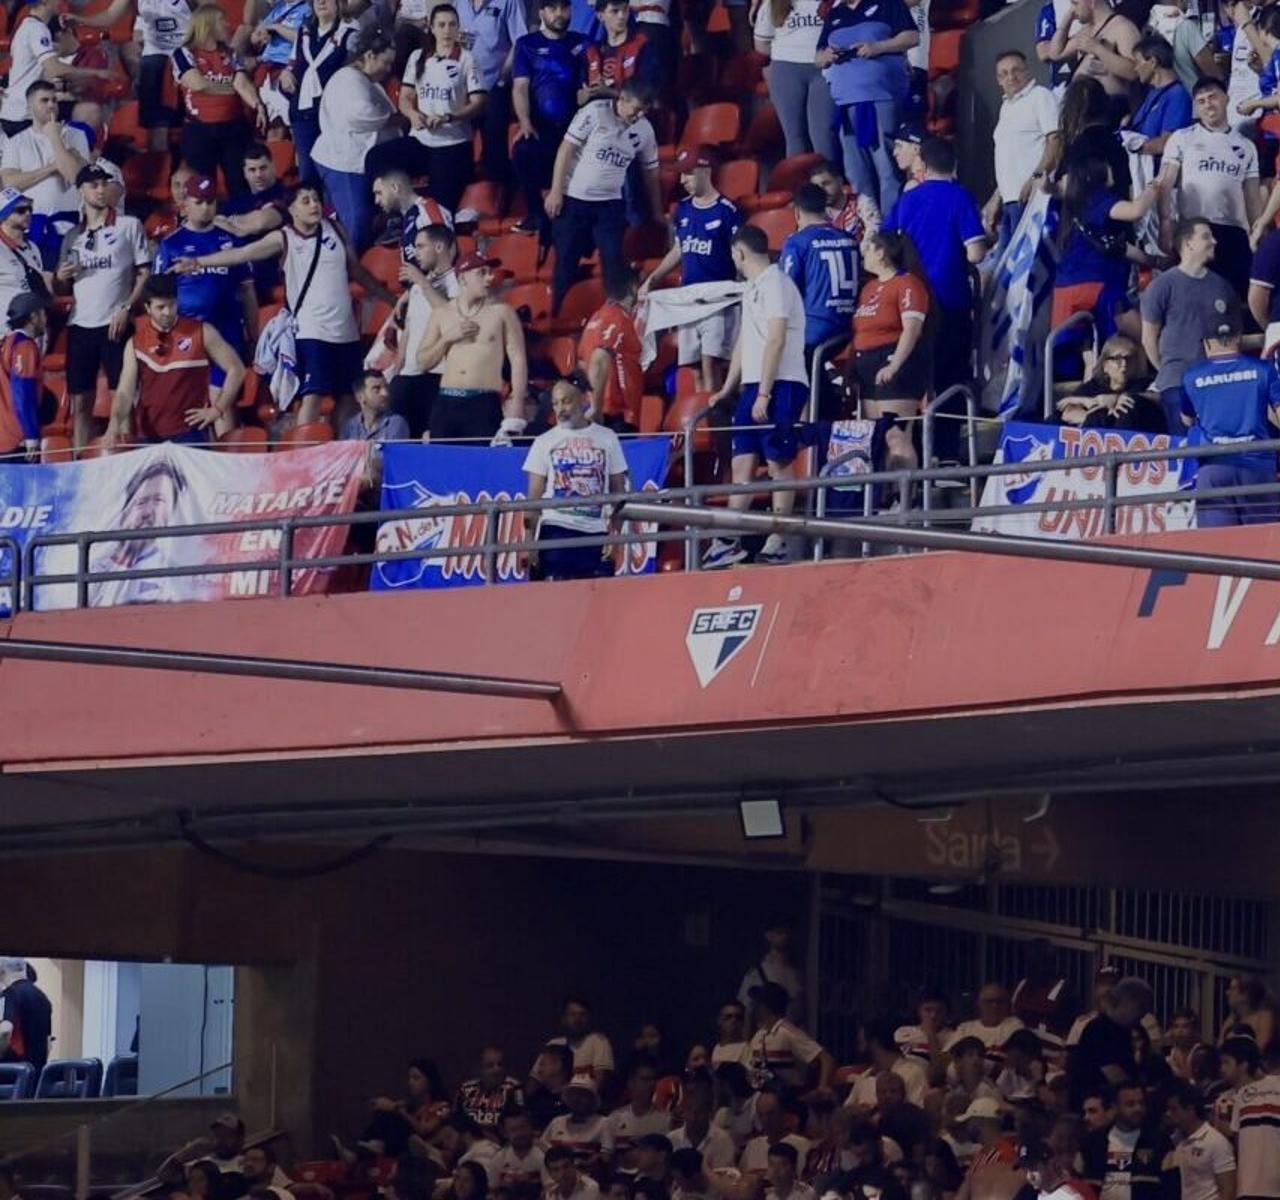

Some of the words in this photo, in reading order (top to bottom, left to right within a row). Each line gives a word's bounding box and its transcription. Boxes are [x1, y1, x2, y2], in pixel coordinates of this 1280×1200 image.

[1199, 157, 1241, 176] antel
[682, 235, 713, 255] antel
[821, 250, 859, 300] 14
[1195, 370, 1258, 388] SARUBBI
[229, 569, 270, 596] MI
